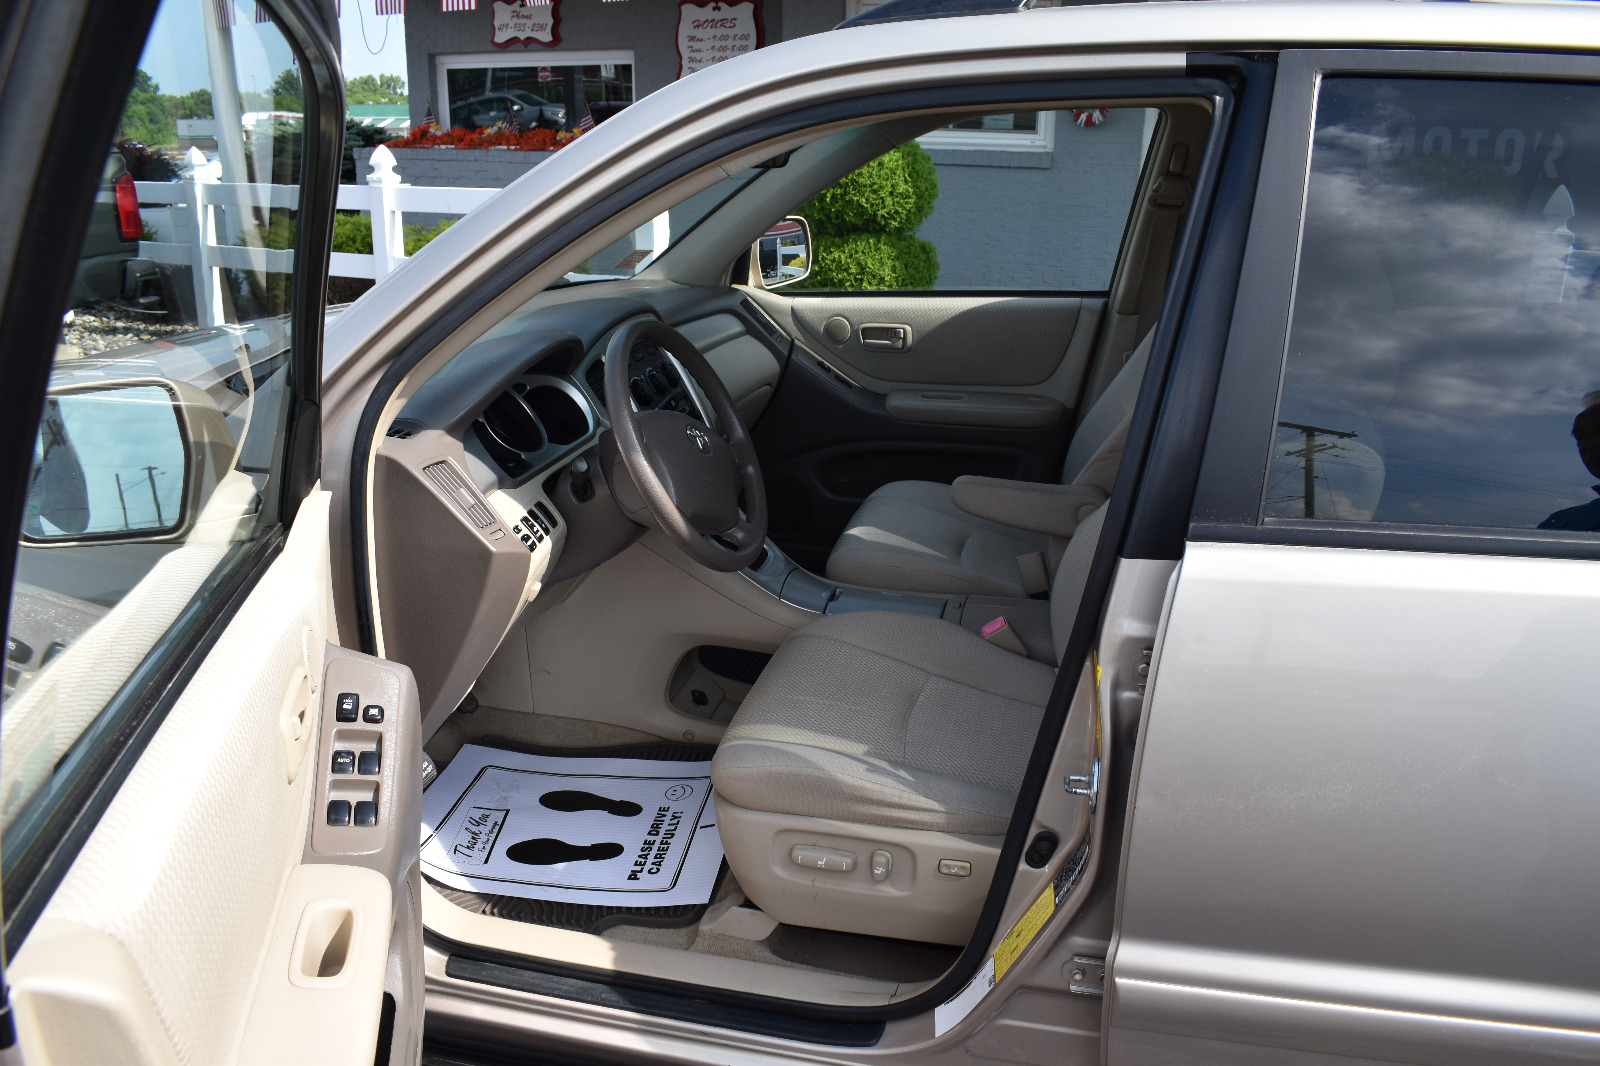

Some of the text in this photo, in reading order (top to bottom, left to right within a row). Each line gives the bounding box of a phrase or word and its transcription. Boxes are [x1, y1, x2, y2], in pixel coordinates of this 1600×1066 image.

[510, 10, 533, 20] Phone
[691, 17, 738, 31] HOURS
[686, 34, 706, 43] Mon.
[687, 56, 705, 64] Wed.
[453, 813, 491, 858] Thank You
[647, 810, 684, 875] CAREFULLY!
[626, 806, 671, 881] PLEASE DRIVE
